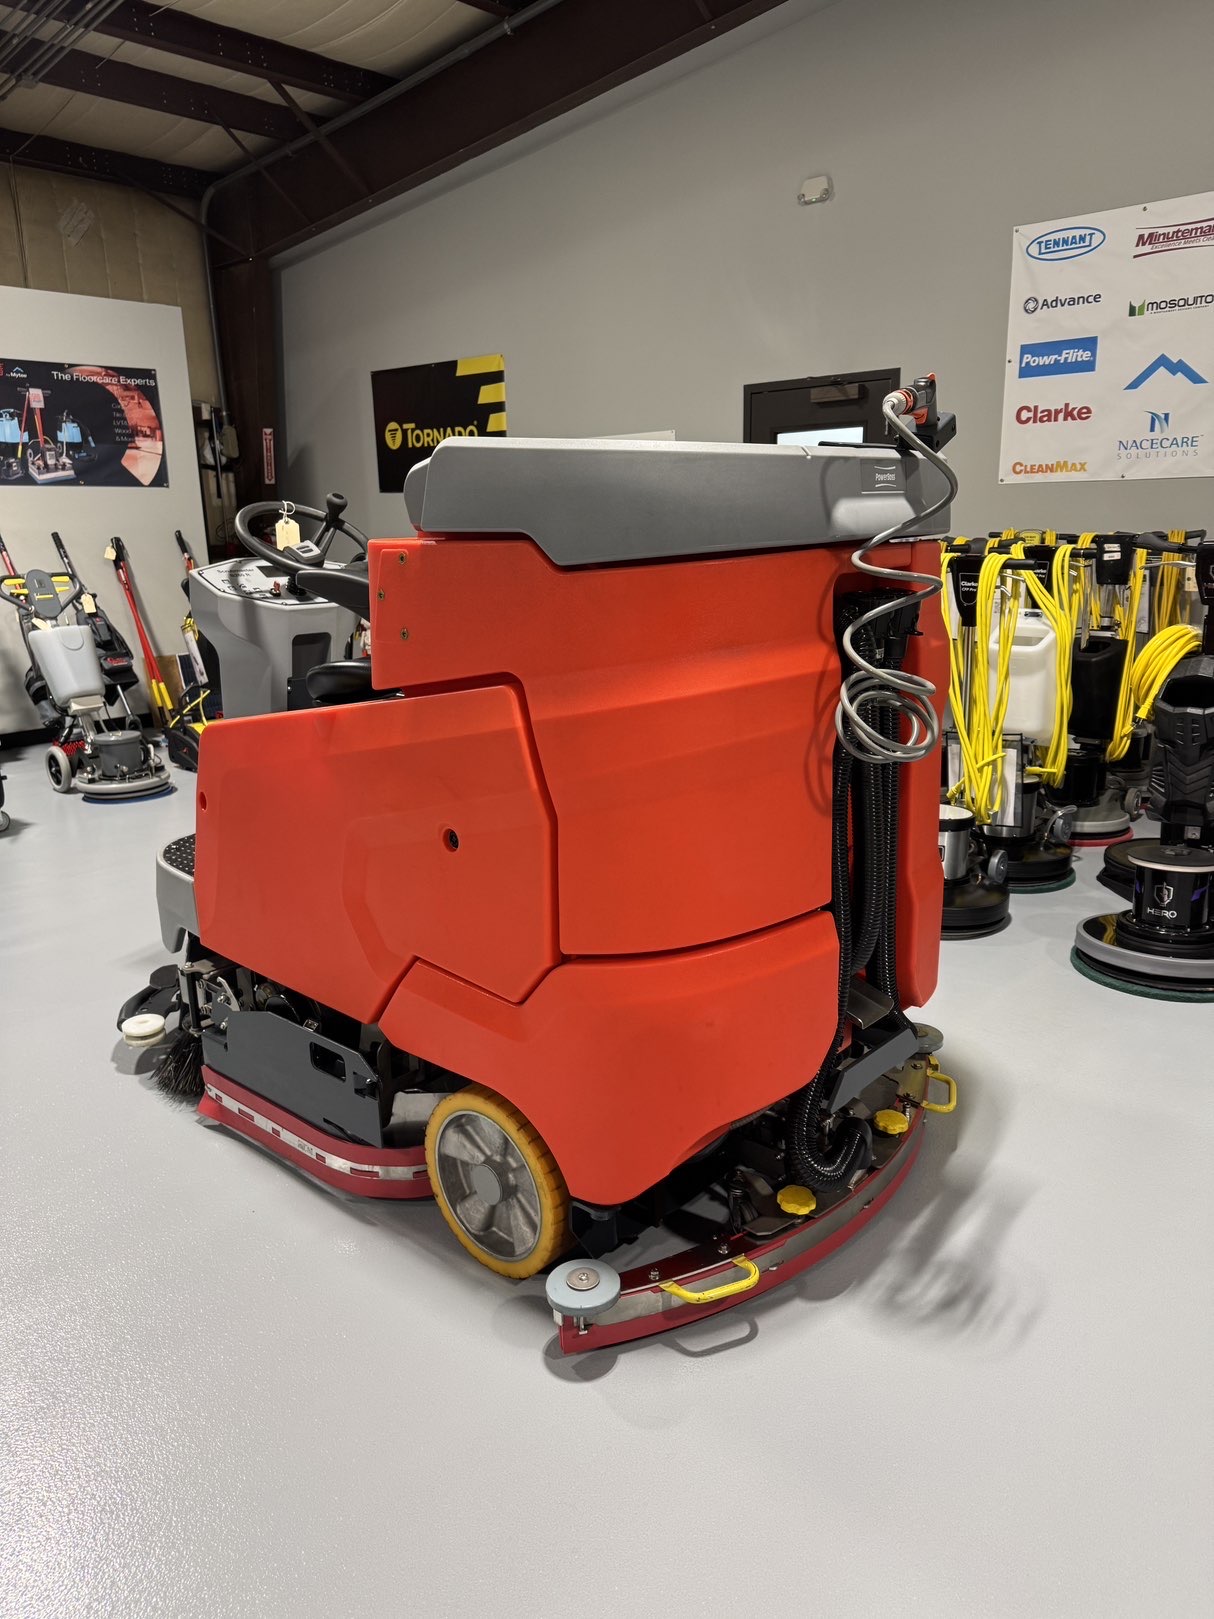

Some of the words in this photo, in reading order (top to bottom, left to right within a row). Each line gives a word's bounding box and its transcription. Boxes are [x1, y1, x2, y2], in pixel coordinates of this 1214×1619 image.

[1037, 232, 1095, 253] TENNANT
[1040, 293, 1101, 310] Advance
[1020, 348, 1094, 367] Powr-Flite
[51, 371, 71, 381] The
[73, 373, 118, 384] Floorcare
[119, 377, 156, 386] Experts
[1015, 402, 1093, 425] Clarke
[1117, 435, 1199, 451] NACECARE
[1116, 450, 1199, 460] SOLUTIONS
[1147, 907, 1177, 919] HERO
